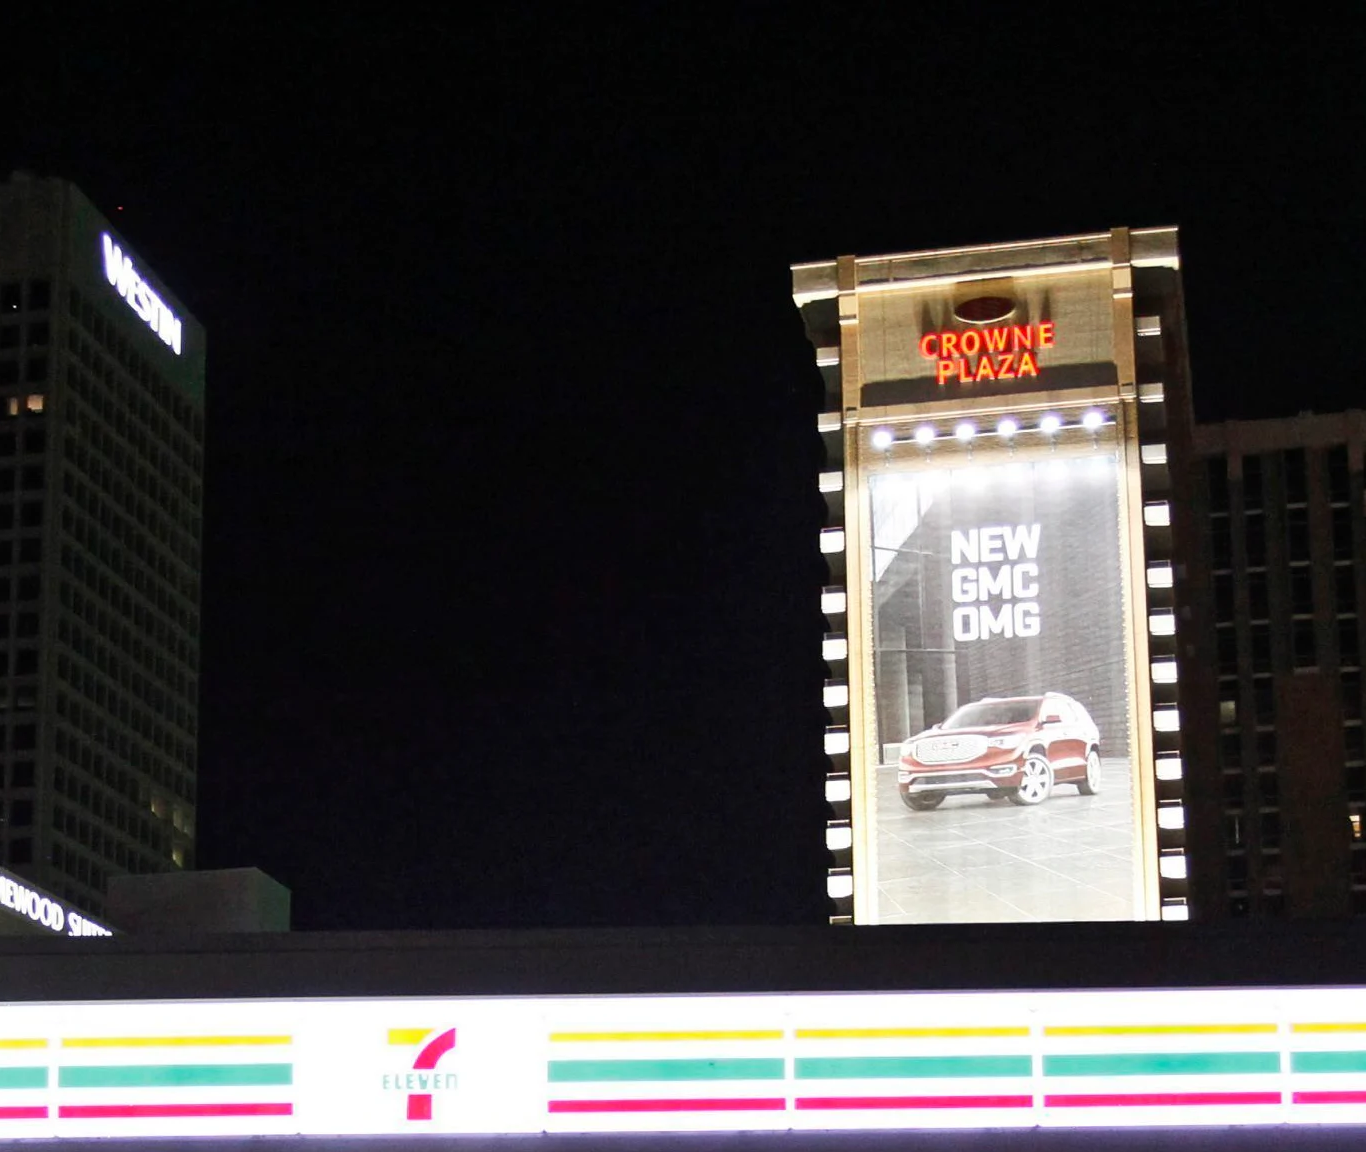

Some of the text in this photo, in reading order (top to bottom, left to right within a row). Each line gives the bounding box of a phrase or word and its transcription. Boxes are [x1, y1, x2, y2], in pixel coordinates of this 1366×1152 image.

[102, 232, 182, 355] WESTIN
[919, 322, 1055, 359] CROWNE
[937, 352, 1039, 385] PLAZA
[951, 524, 1041, 564] NEW
[952, 563, 1039, 602] GMC
[953, 602, 1041, 642] OMG
